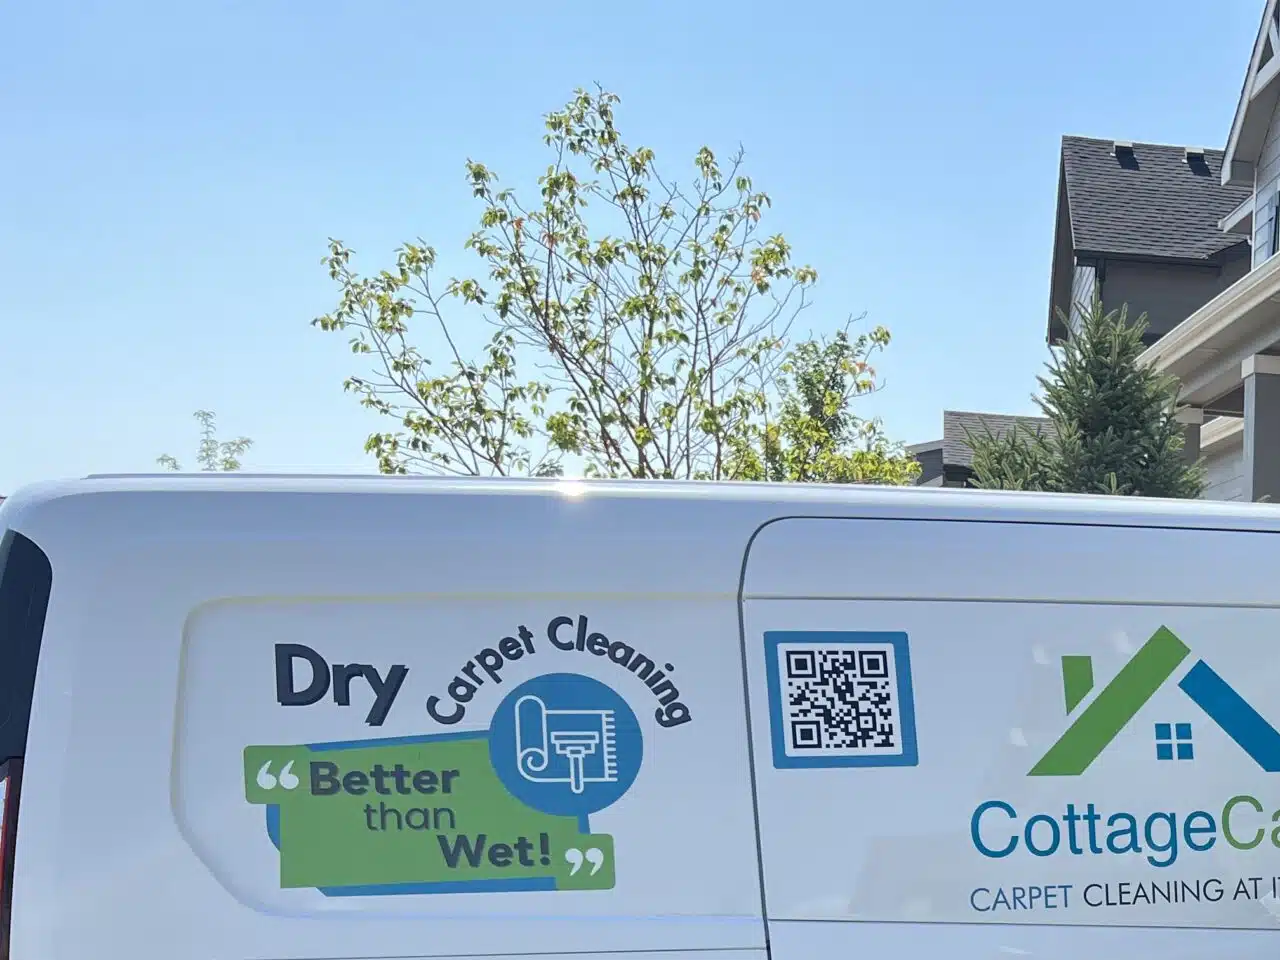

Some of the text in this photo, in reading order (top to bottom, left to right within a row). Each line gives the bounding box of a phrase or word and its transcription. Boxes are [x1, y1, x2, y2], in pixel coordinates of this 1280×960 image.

[274, 642, 409, 727] Dry
[425, 614, 693, 729] Carpet Cleaning
[362, 801, 456, 831] than
[969, 885, 1074, 912] CARPET
[1082, 878, 1225, 906] CLEANING
[1232, 876, 1263, 900] AT
